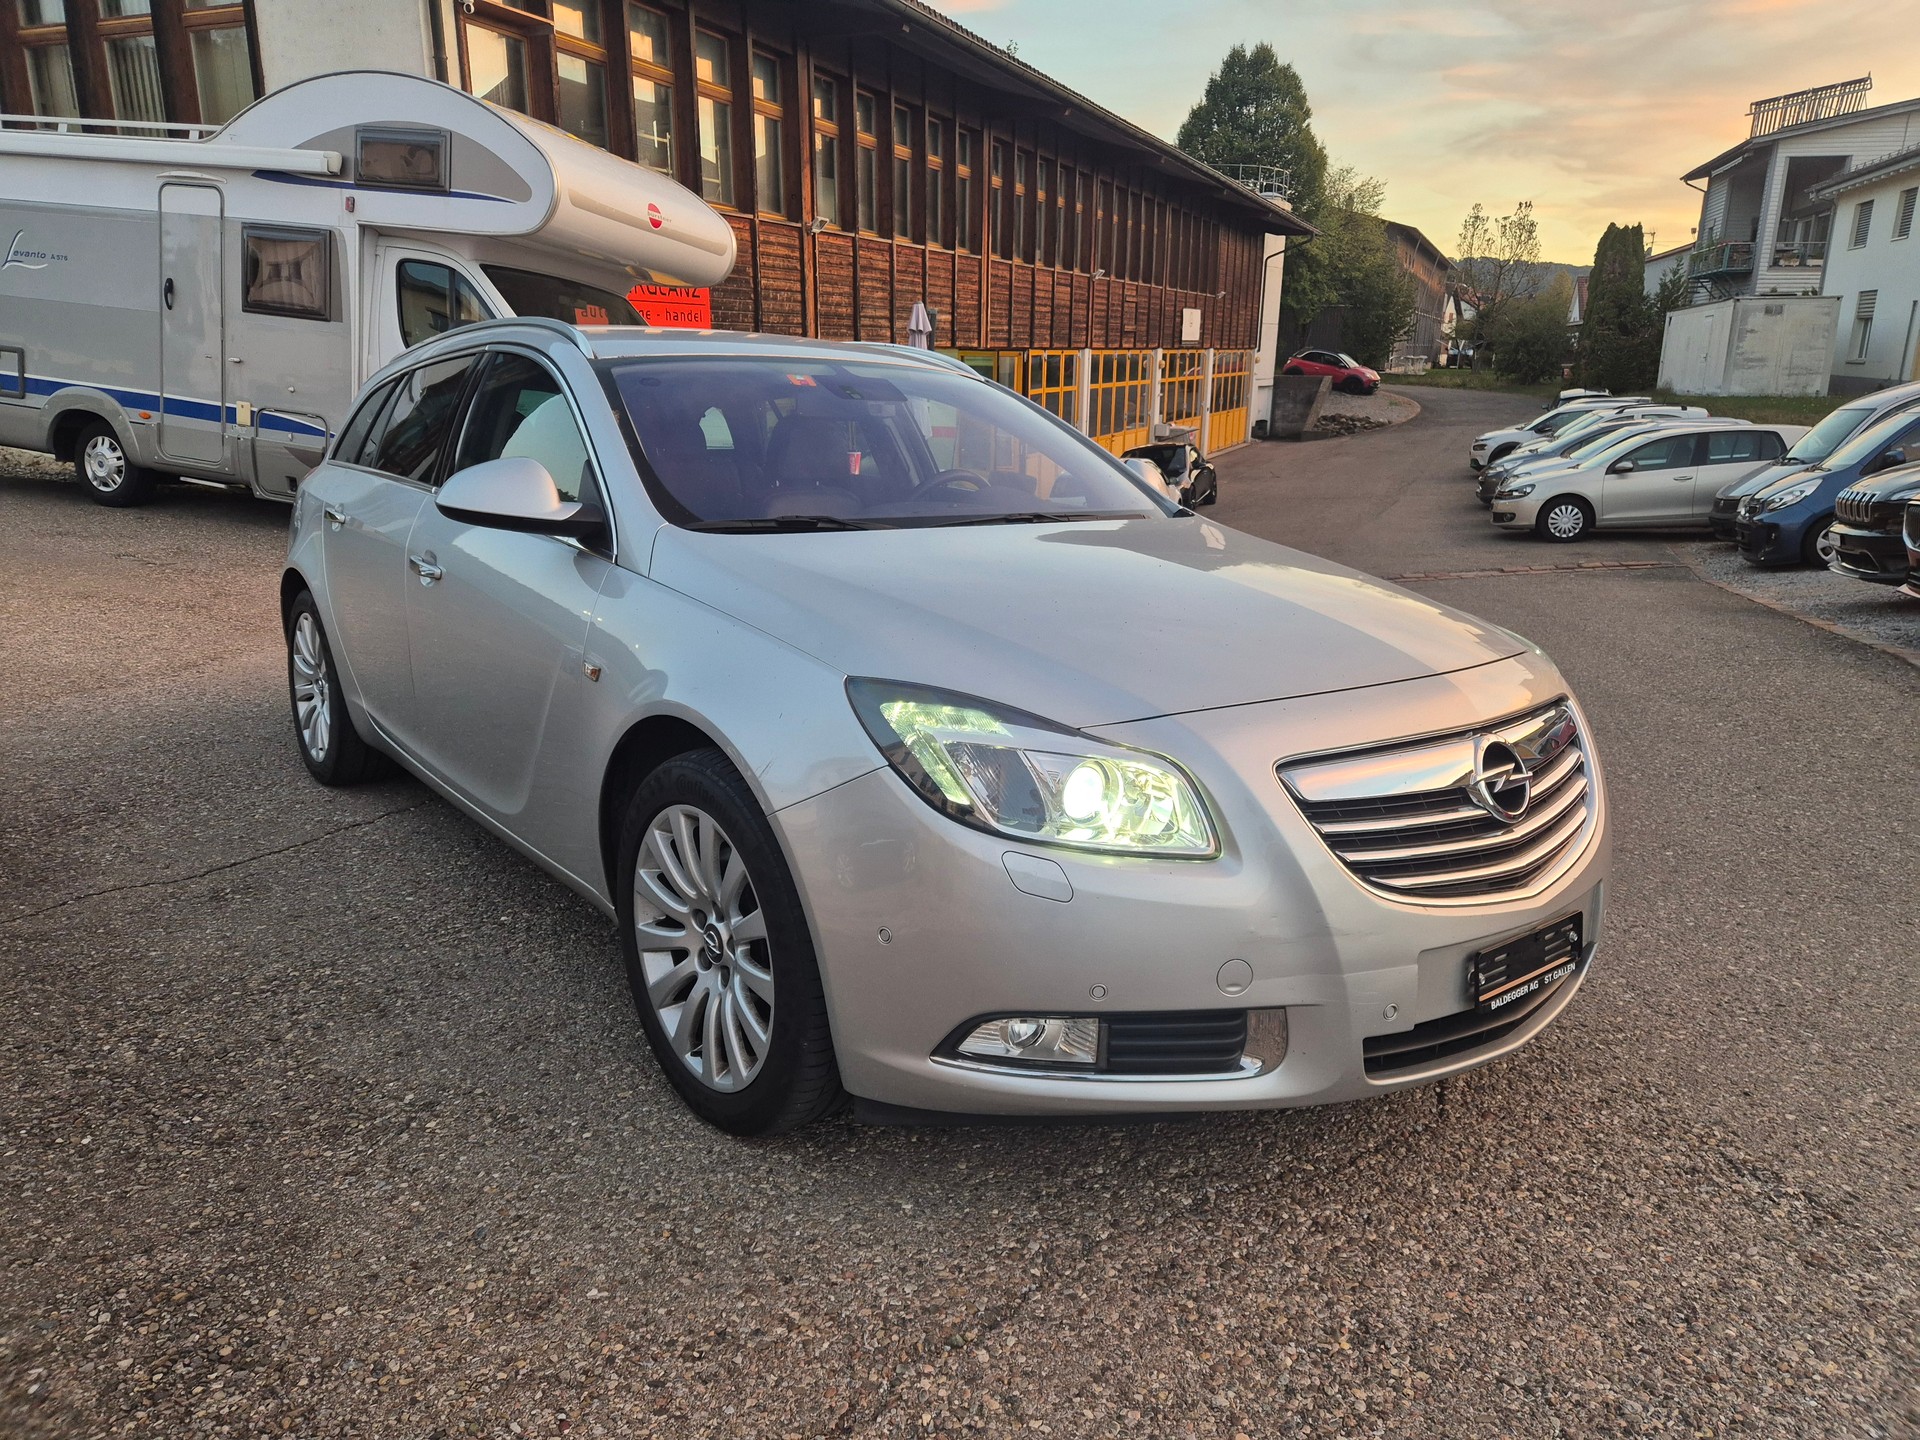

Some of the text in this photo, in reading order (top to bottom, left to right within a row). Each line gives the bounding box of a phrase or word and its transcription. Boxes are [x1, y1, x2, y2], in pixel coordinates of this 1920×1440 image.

[1, 229, 48, 270] Levanto
[665, 307, 703, 322] handel
[1490, 985, 1529, 1010] BALDEGGER
[1529, 980, 1539, 991] AG
